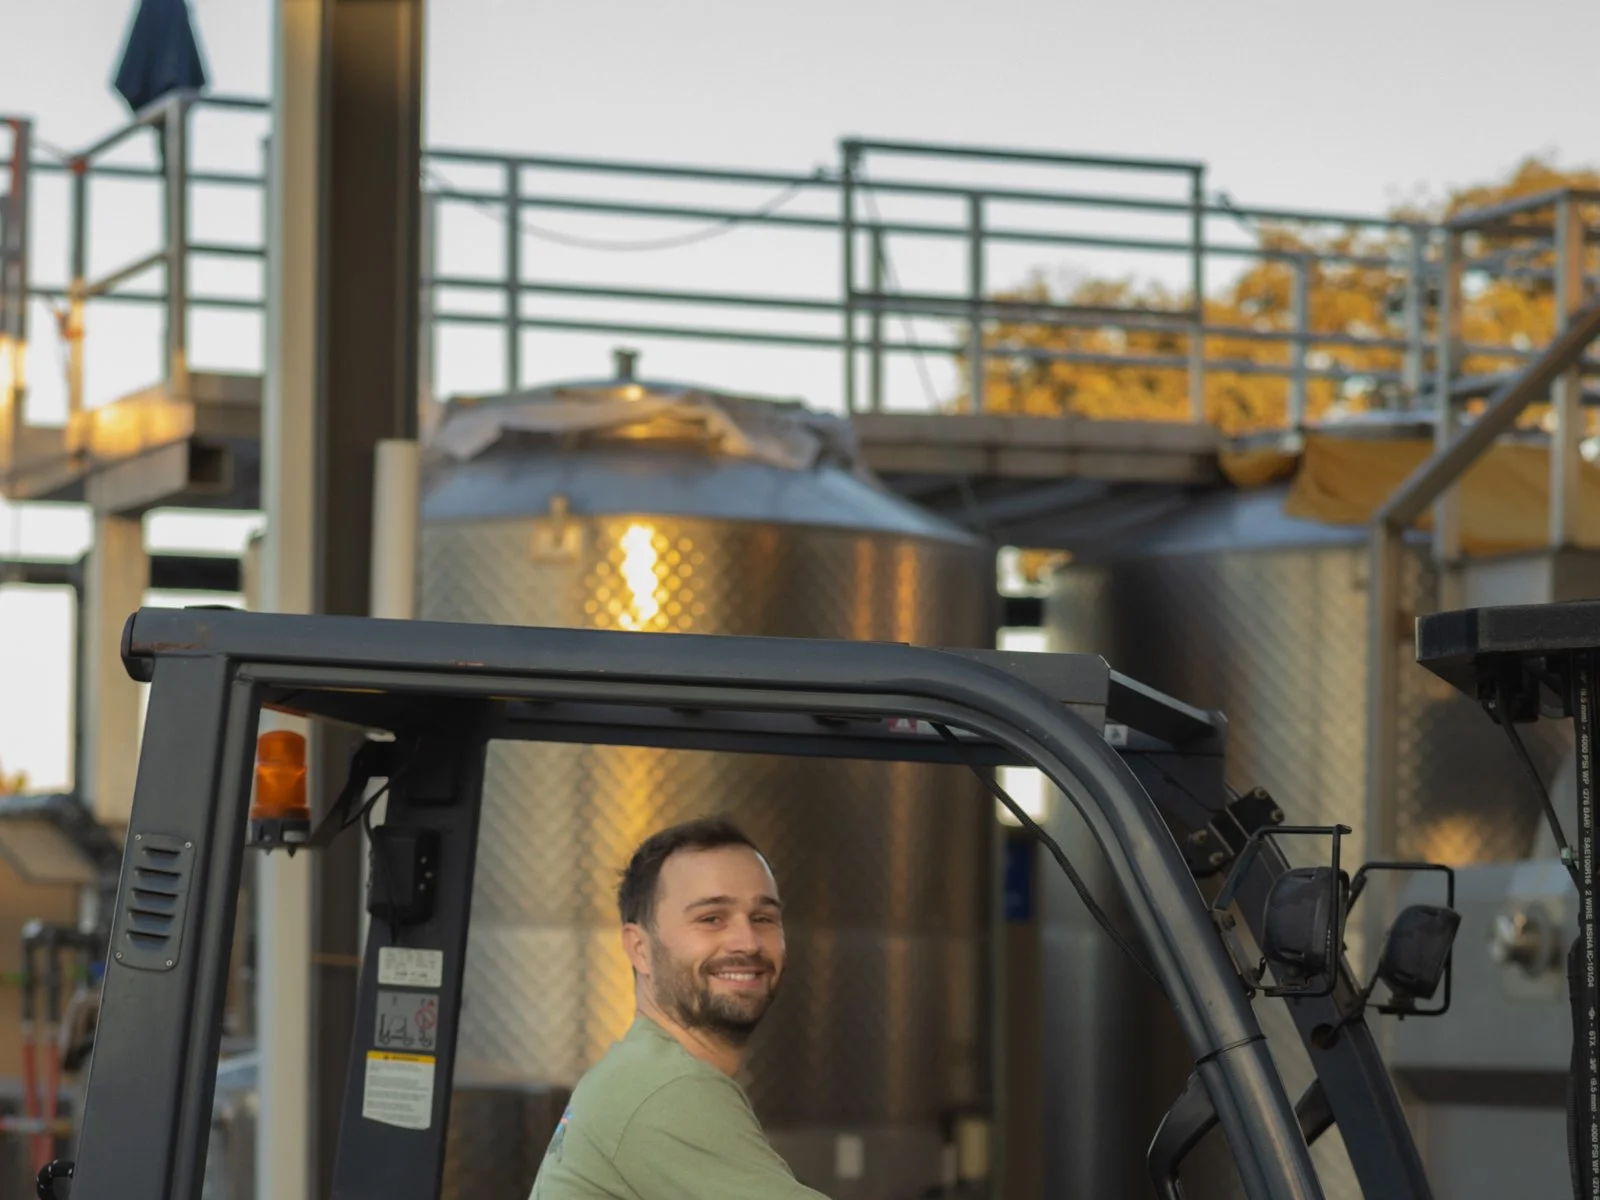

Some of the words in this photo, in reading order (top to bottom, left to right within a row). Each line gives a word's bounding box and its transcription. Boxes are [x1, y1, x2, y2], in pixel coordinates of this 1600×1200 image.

[1581, 733, 1589, 753] 4000
[1581, 755, 1590, 769] PSI
[1582, 770, 1590, 785] WP
[1583, 807, 1592, 828] BAR)
[1585, 897, 1594, 920] WIRE
[1586, 924, 1594, 949] MSHA
[1590, 1077, 1598, 1092] (9.5
[1590, 1094, 1598, 1112] mm)
[1591, 1122, 1599, 1142] 4000
[1591, 1144, 1599, 1158] PSI
[1592, 1159, 1600, 1174] WP
